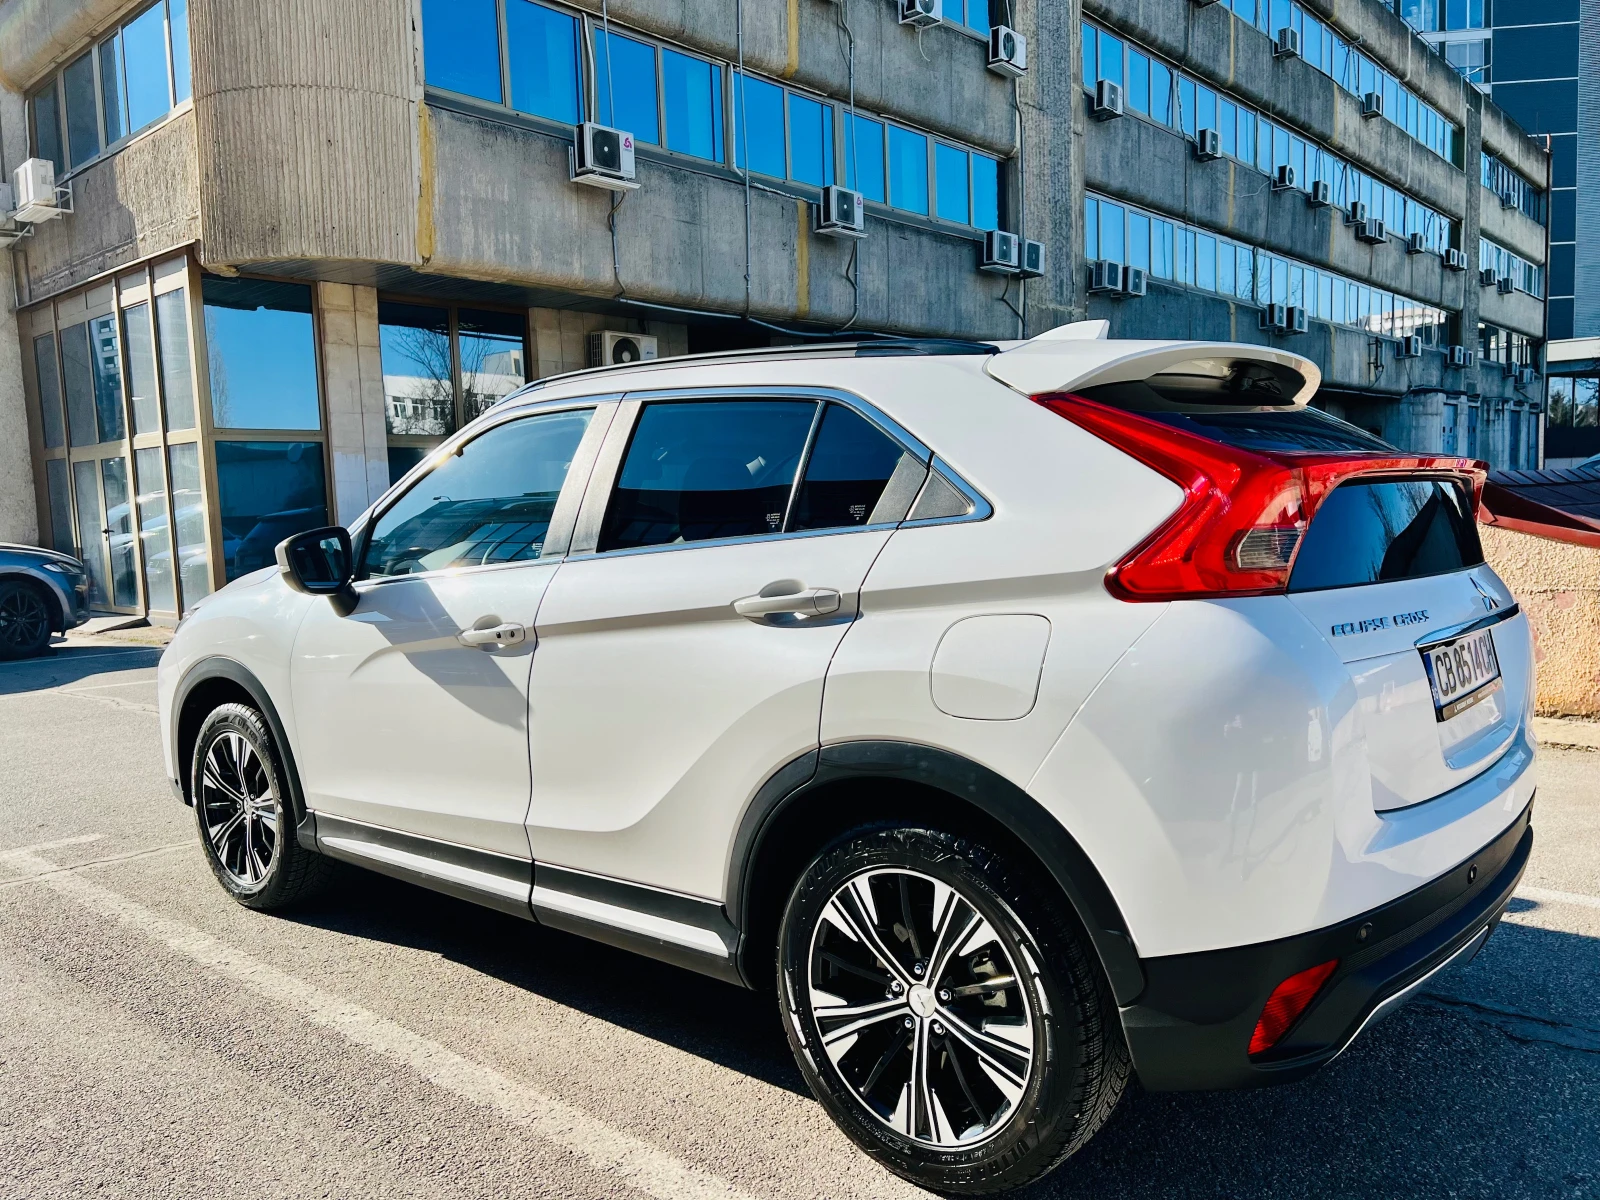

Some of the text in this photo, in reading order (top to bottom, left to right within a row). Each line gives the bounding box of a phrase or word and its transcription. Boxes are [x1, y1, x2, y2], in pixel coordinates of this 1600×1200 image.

[1331, 609, 1430, 637] ECLIPSE CROSS
[976, 1141, 1031, 1181] ULTRA
